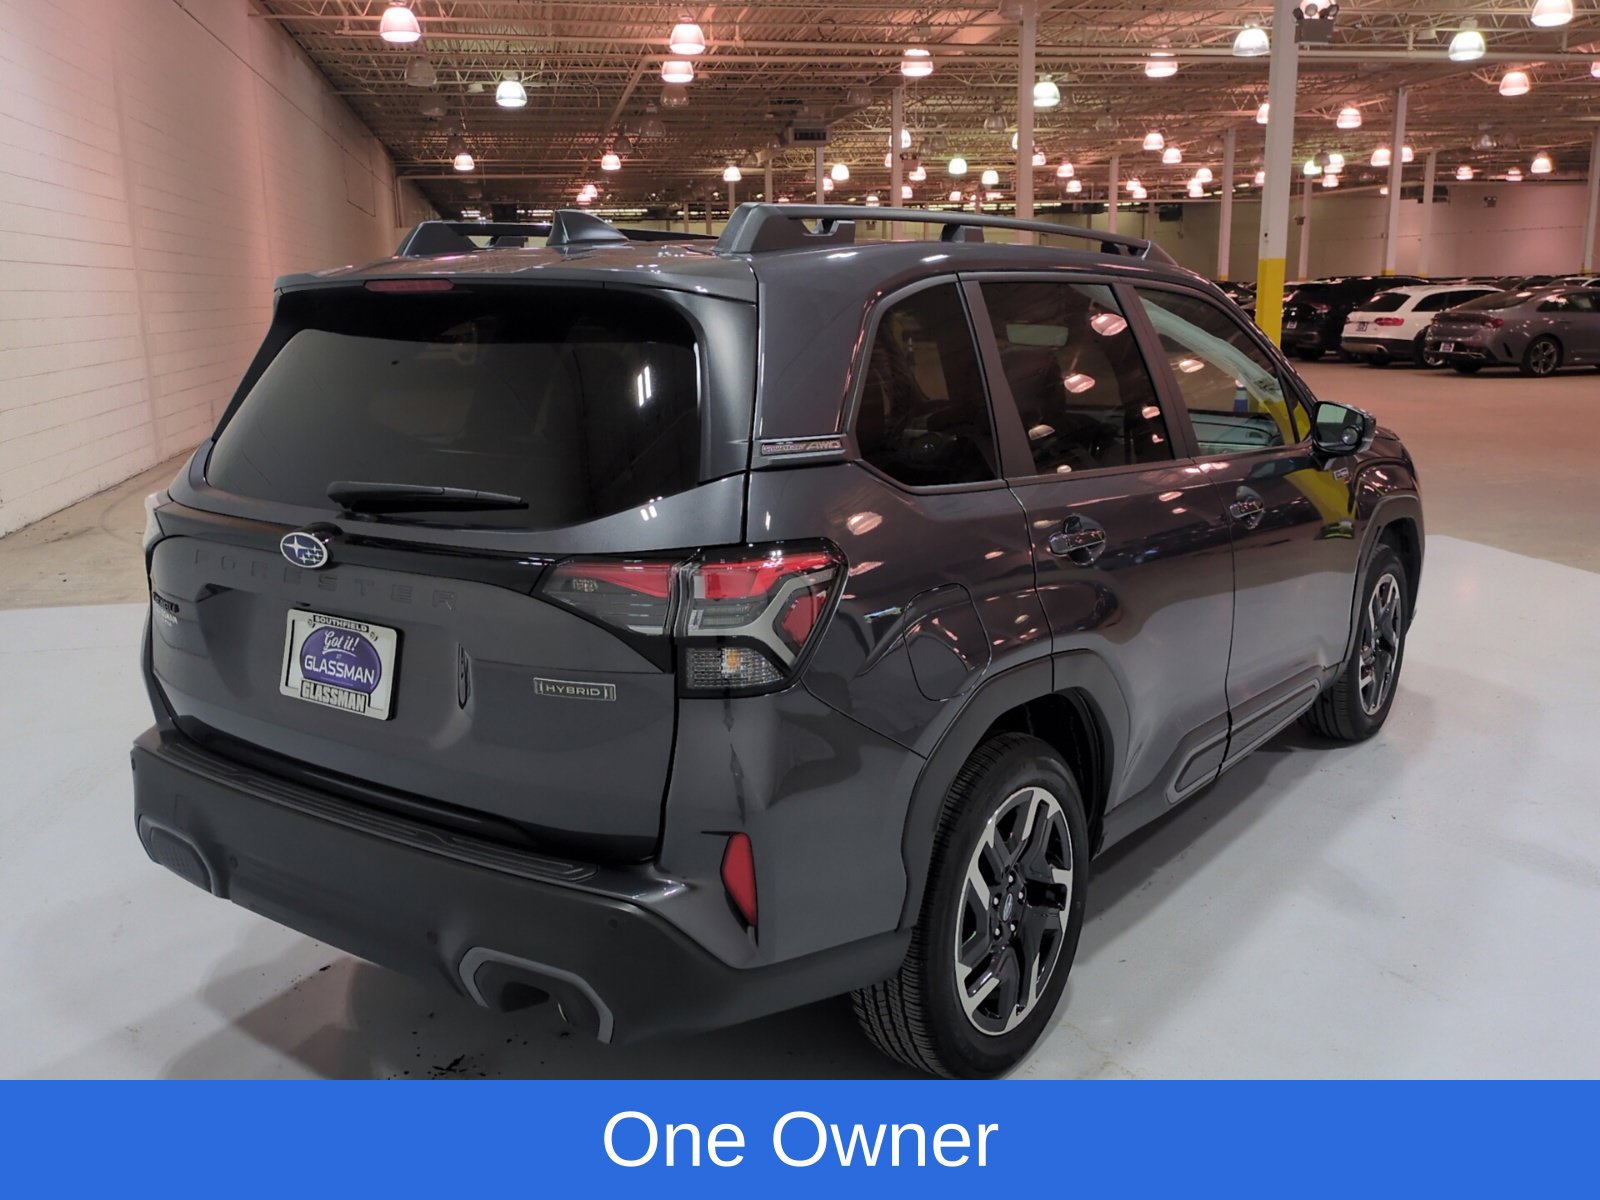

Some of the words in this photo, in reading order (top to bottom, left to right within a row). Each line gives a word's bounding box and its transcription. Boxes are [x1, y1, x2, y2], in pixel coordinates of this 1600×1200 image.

[194, 548, 458, 609] FORESTER
[314, 615, 369, 632] SOUTHFIELD
[324, 630, 344, 651] Got
[343, 635, 360, 652] it!
[304, 654, 375, 685] GLASSMAN
[301, 680, 366, 713] GLASSMAN
[545, 684, 601, 696] HYBRID
